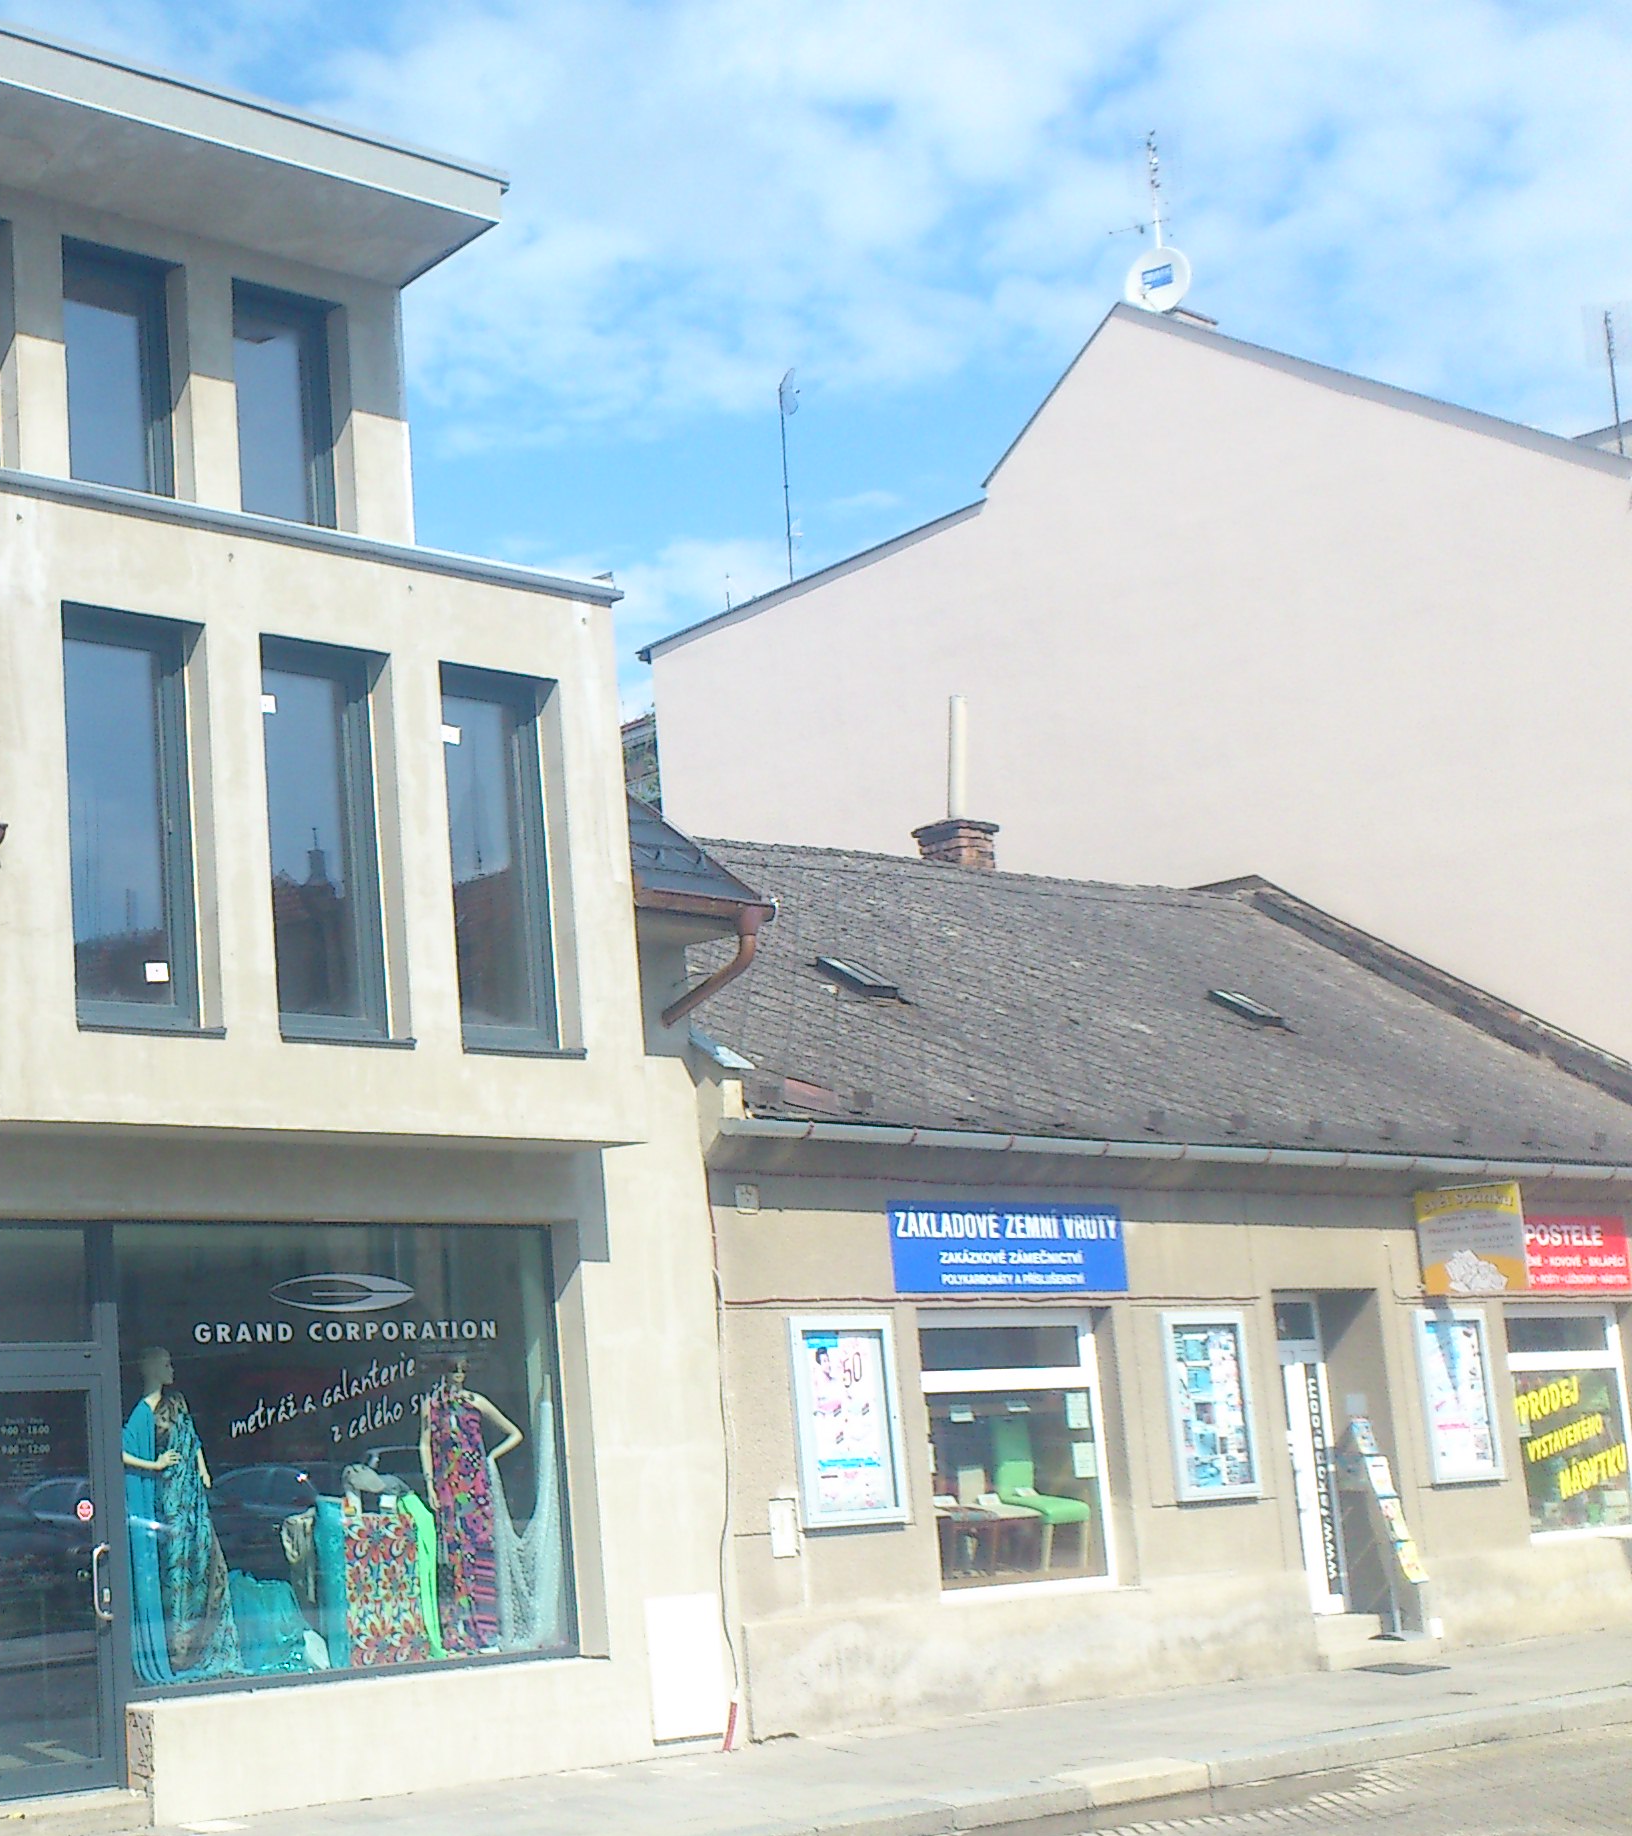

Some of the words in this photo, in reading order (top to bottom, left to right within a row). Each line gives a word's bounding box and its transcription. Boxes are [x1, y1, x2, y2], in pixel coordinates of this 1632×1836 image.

[894, 1206, 1002, 1239] ZÁKLADOVÉ
[1004, 1208, 1060, 1240] ZEMNÍ
[1064, 1213, 1118, 1240] VRUTY
[1524, 1223, 1604, 1247] POSTELE
[939, 1248, 1007, 1265] ZAKÁZKOVÉ
[1009, 1248, 1085, 1265] ZÁMEČNICTVÍ
[193, 1321, 295, 1343] GRAND
[307, 1319, 498, 1342] CORPORATION
[843, 1351, 862, 1388] 50
[230, 1392, 298, 1438] metráž
[304, 1395, 316, 1414] a
[331, 1424, 342, 1442] z
[348, 1394, 404, 1439] celého
[1527, 1412, 1604, 1463] VYSTAVENÉHO
[1559, 1442, 1627, 1500] NÁBYTKU
